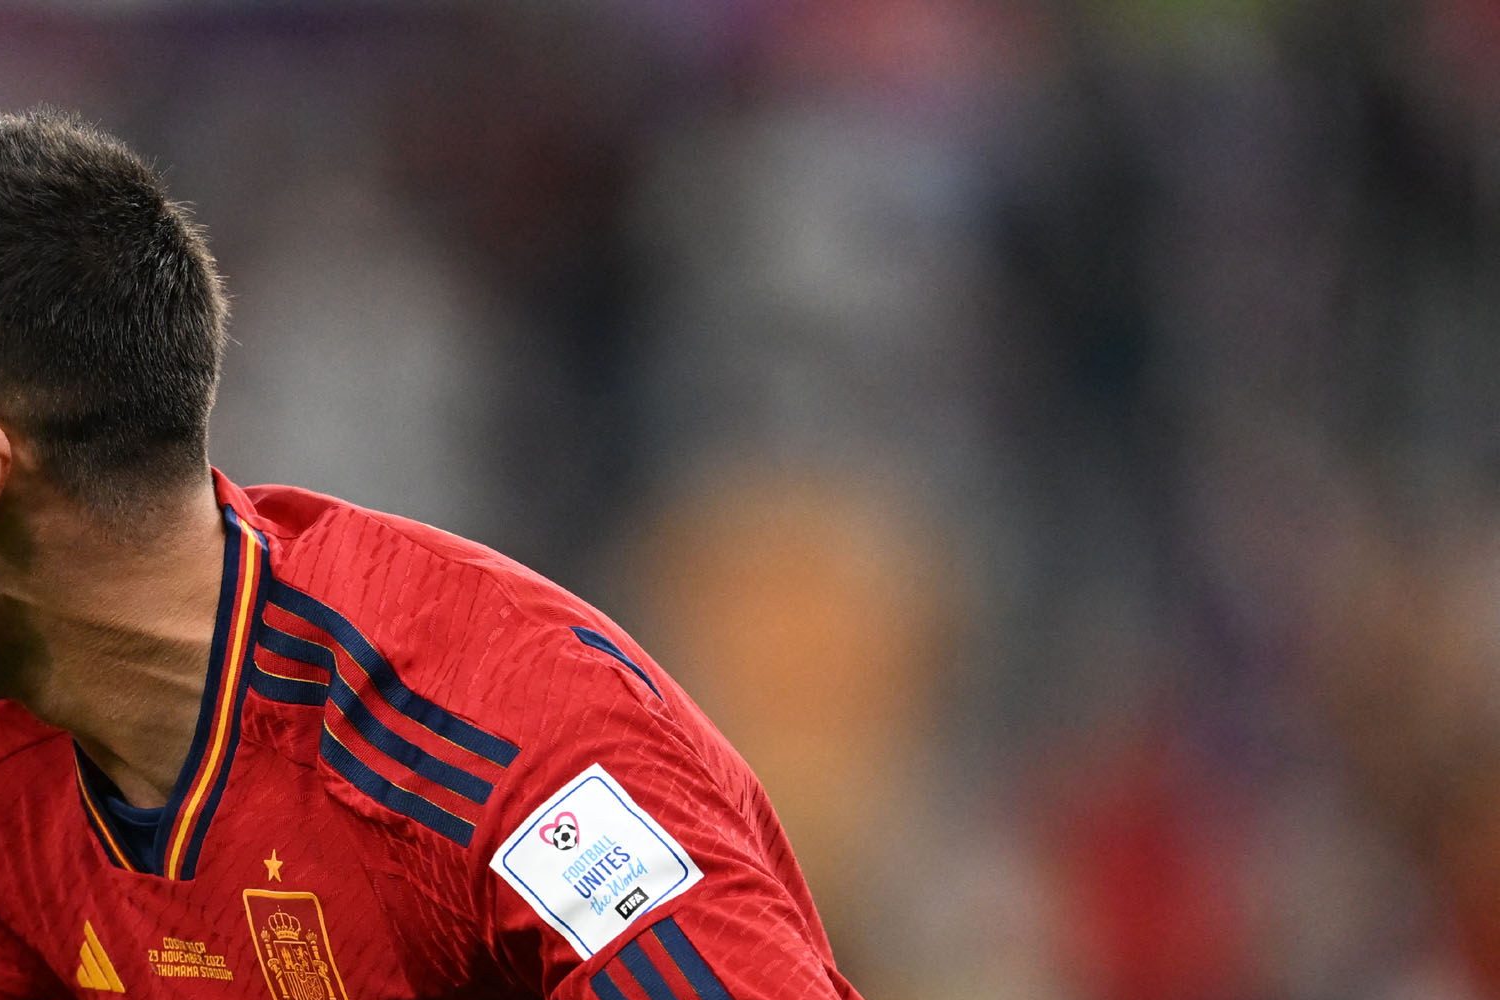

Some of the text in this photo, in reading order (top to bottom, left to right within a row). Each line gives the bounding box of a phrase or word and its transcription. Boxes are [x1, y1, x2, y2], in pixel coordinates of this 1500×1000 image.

[562, 834, 617, 884] FOOTBALL
[573, 845, 631, 899] UNITES
[589, 857, 648, 916] the World
[619, 891, 646, 916] FIFA
[148, 949, 226, 967] 23 NOVEMBER 2022
[156, 963, 234, 981] THUMAMA STADIUM
